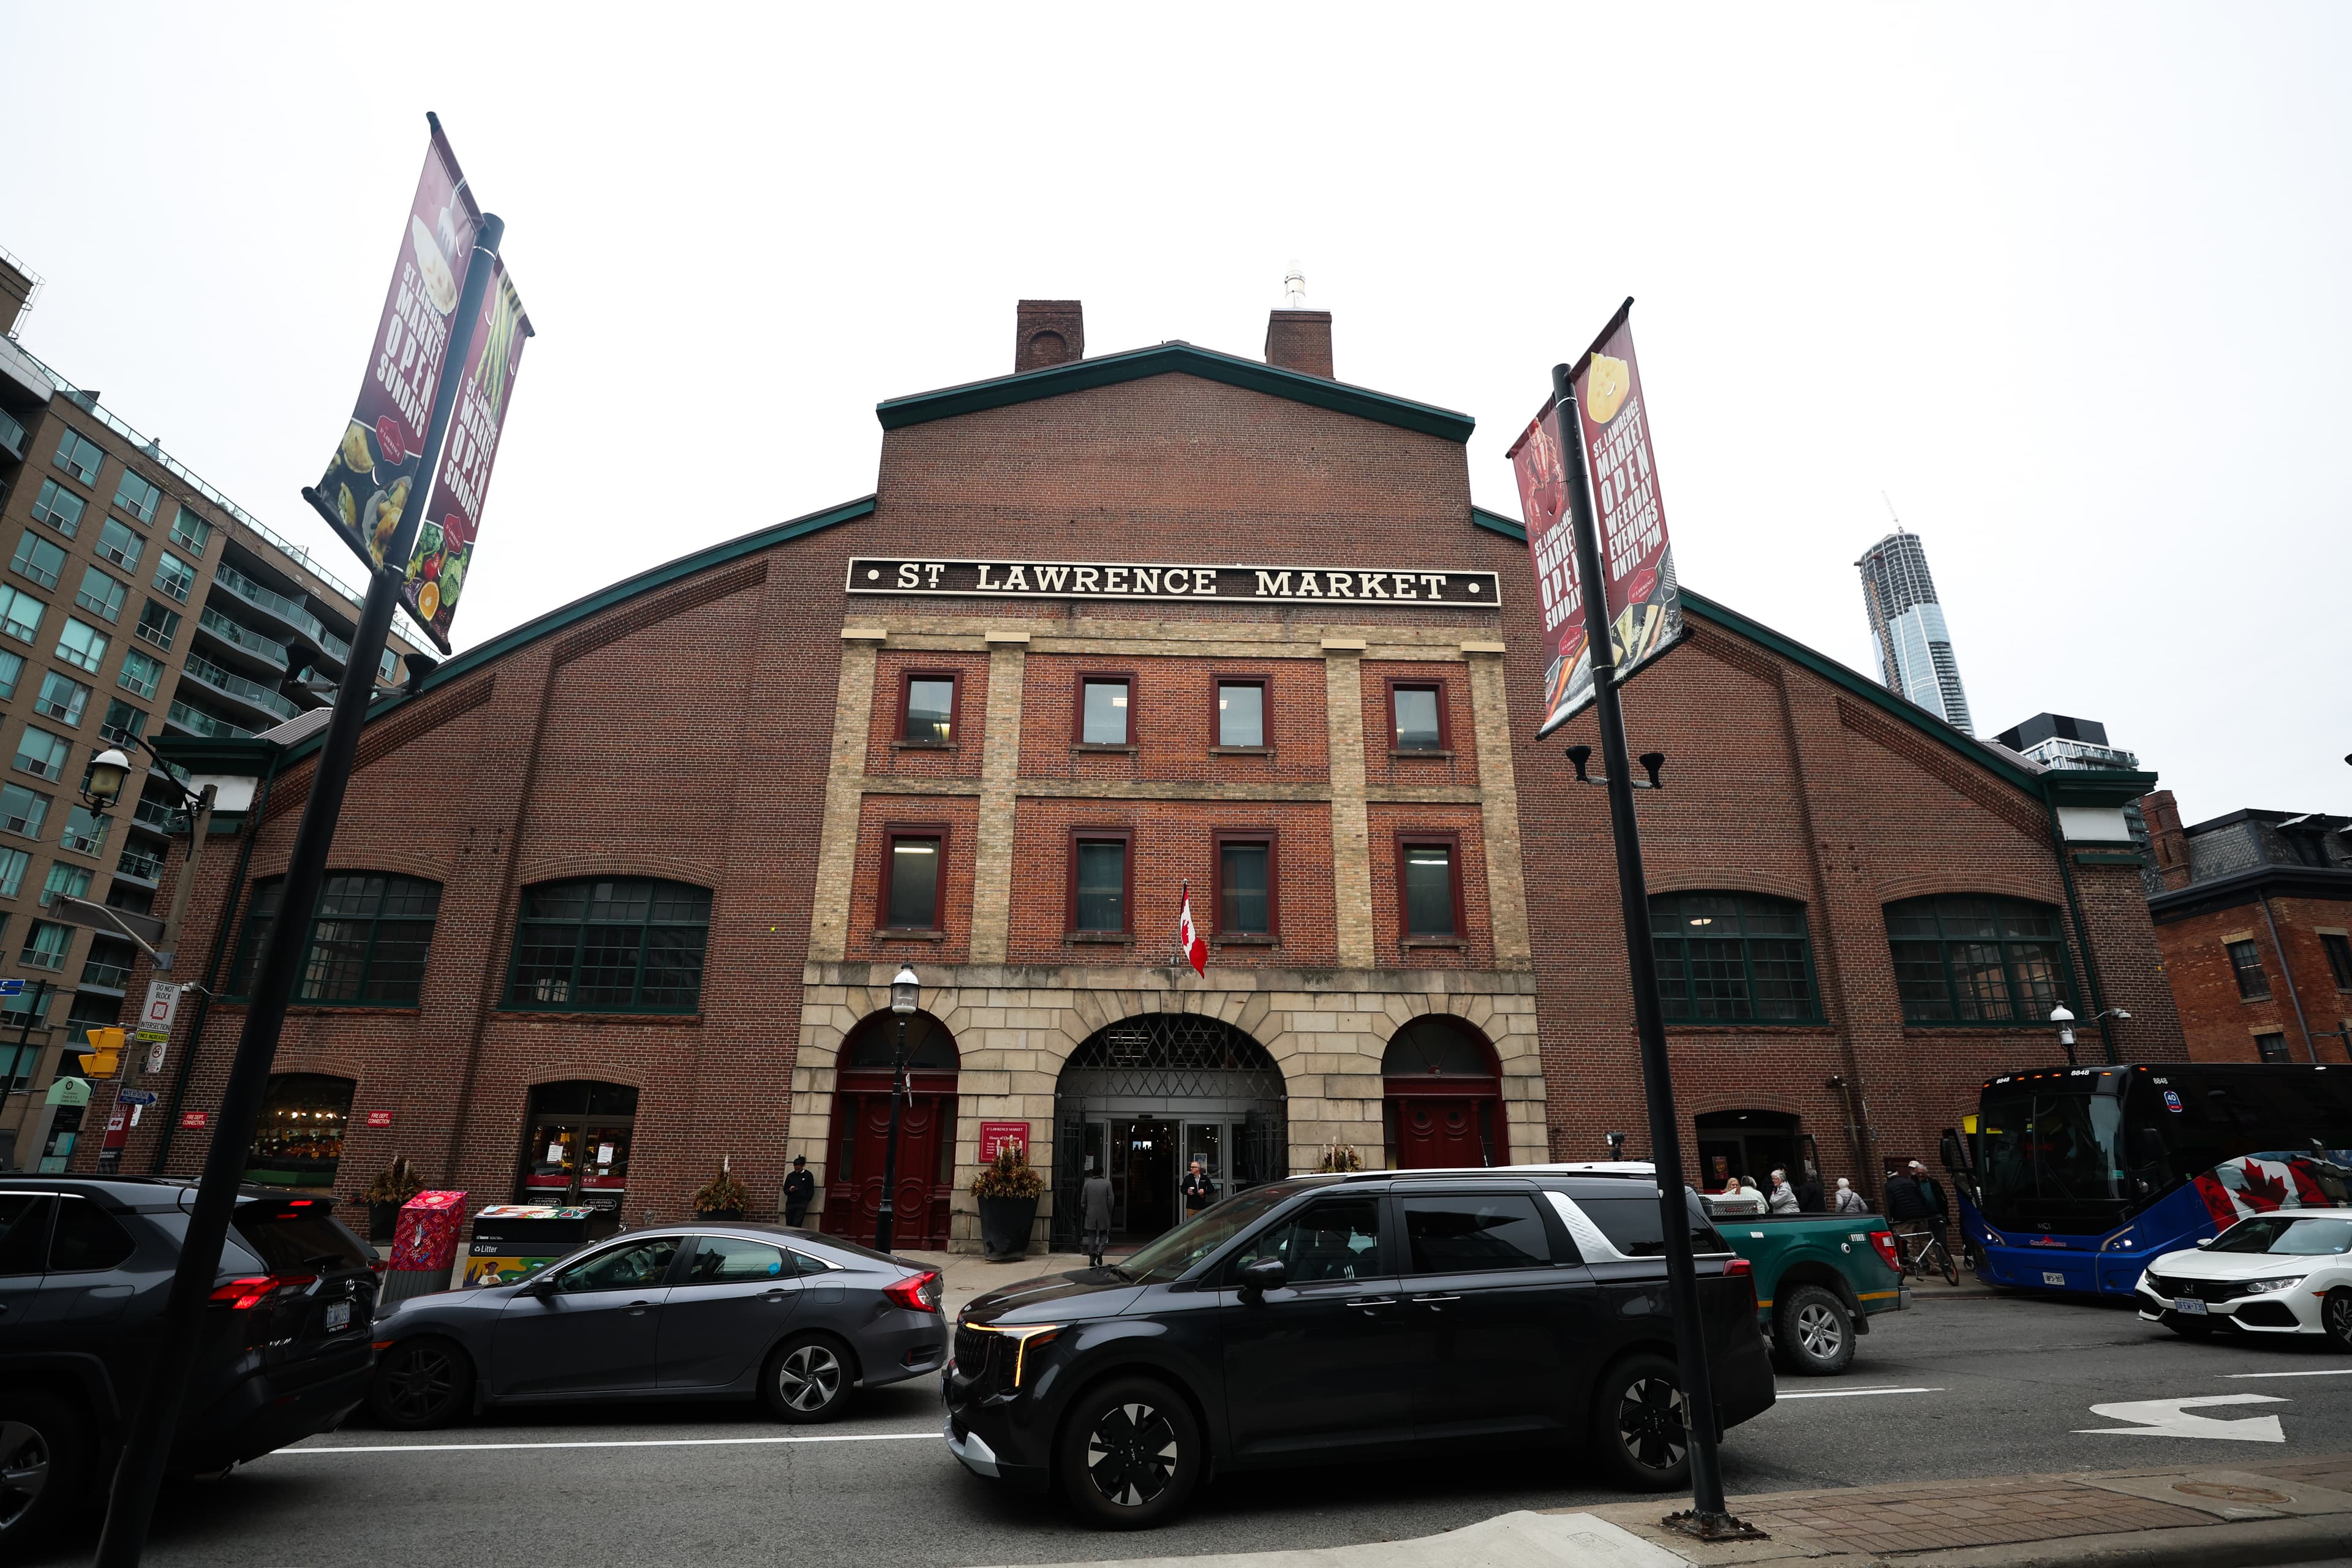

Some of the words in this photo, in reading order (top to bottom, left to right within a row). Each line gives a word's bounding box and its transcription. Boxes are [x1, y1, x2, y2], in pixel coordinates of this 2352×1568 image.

[396, 281, 442, 373] MARKET
[404, 262, 417, 292] ST.
[415, 279, 447, 346] LAWRENCE
[377, 353, 426, 439] SUNDAYS
[385, 314, 435, 413] OPEN
[466, 377, 476, 402] ST.
[460, 394, 494, 469] MARKET
[1593, 437, 1605, 458] ST.
[1604, 396, 1640, 448] LAWRENCE
[1596, 412, 1643, 483] MARKET
[444, 459, 479, 528] SUNDAYS
[451, 424, 488, 505] OPEN
[1600, 439, 1650, 515] OPEN
[1605, 472, 1654, 538] WEEKDAY
[1608, 497, 1659, 561] EVENINGS
[1534, 538, 1545, 557] ST.
[1611, 541, 1642, 582] UNTIL
[1640, 521, 1662, 560] 7PM
[976, 565, 1217, 594] LAWRENCE
[1255, 571, 1446, 599] MARKET
[1545, 584, 1583, 632] SUNDAY
[140, 1022, 170, 1030] INTERSECTION
[123, 1090, 148, 1098] WATERFRONT
[481, 1245, 498, 1253] Litter
